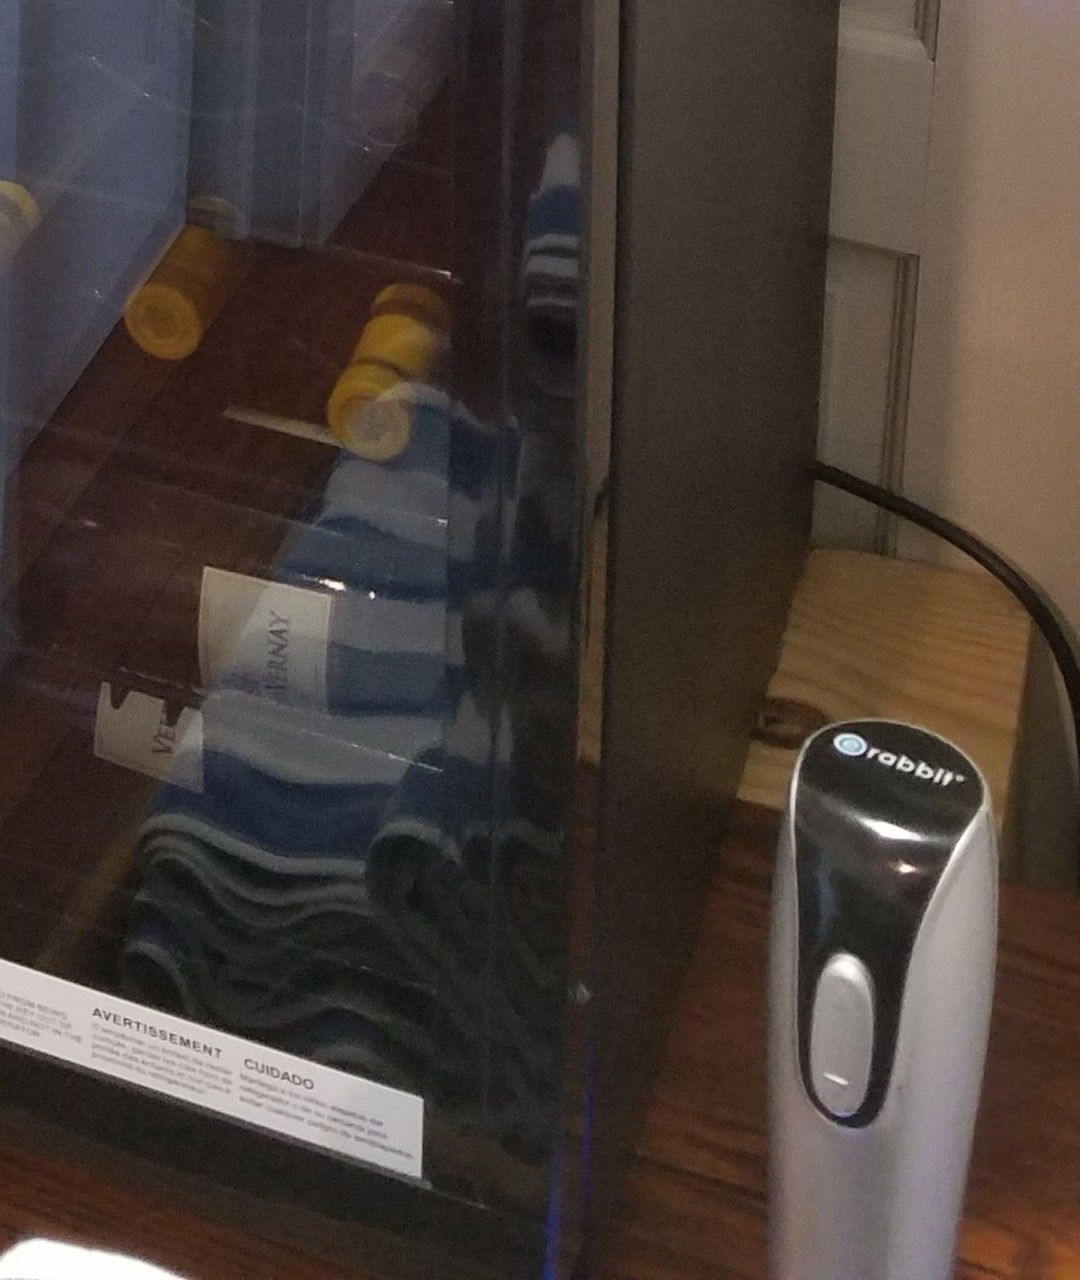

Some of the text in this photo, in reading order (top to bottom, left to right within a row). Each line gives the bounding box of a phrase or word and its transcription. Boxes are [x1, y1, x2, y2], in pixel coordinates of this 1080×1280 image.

[866, 747, 954, 787] rabbit
[92, 1007, 223, 1059] AVERTISSEMENT
[244, 1058, 315, 1091] CUIDADO
